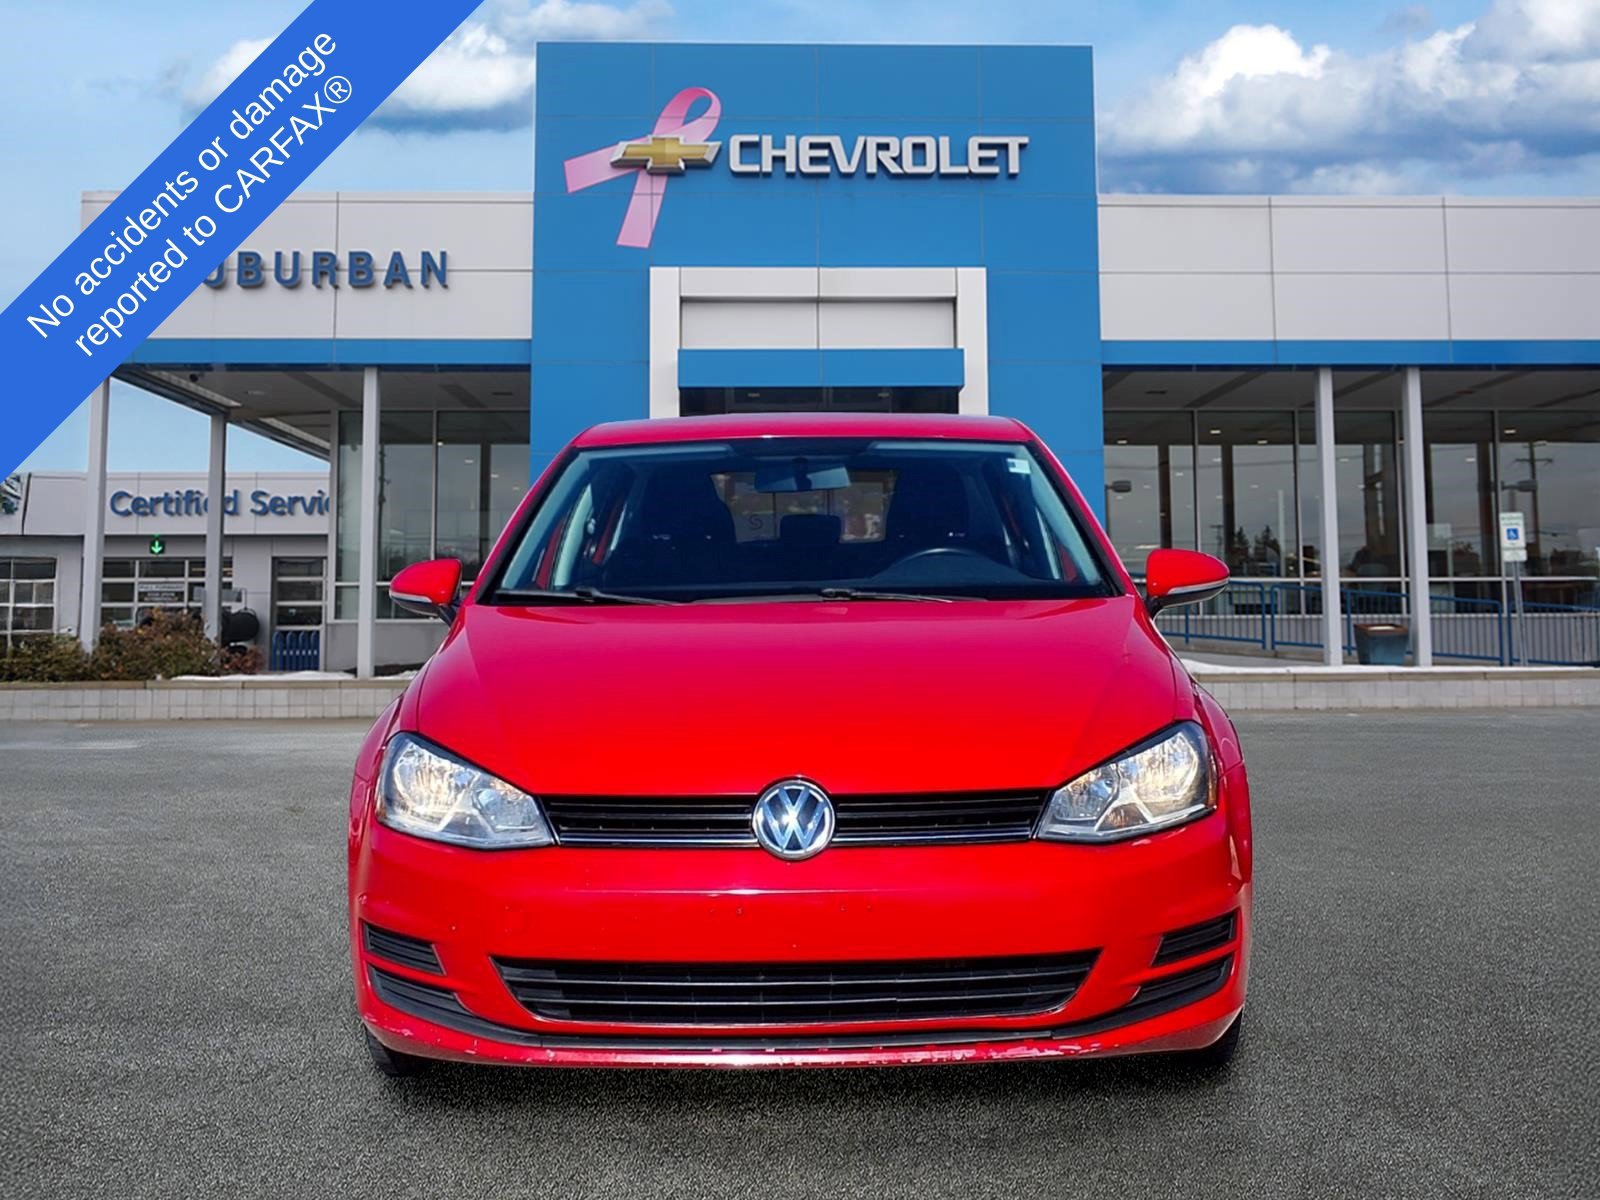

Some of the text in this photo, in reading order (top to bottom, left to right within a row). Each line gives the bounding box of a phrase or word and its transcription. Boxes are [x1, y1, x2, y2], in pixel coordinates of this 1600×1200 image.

[729, 134, 1029, 174] CHEVROLET
[203, 250, 448, 289] UBURBAN
[110, 489, 240, 517] Certifid
[758, 784, 829, 853] VW
